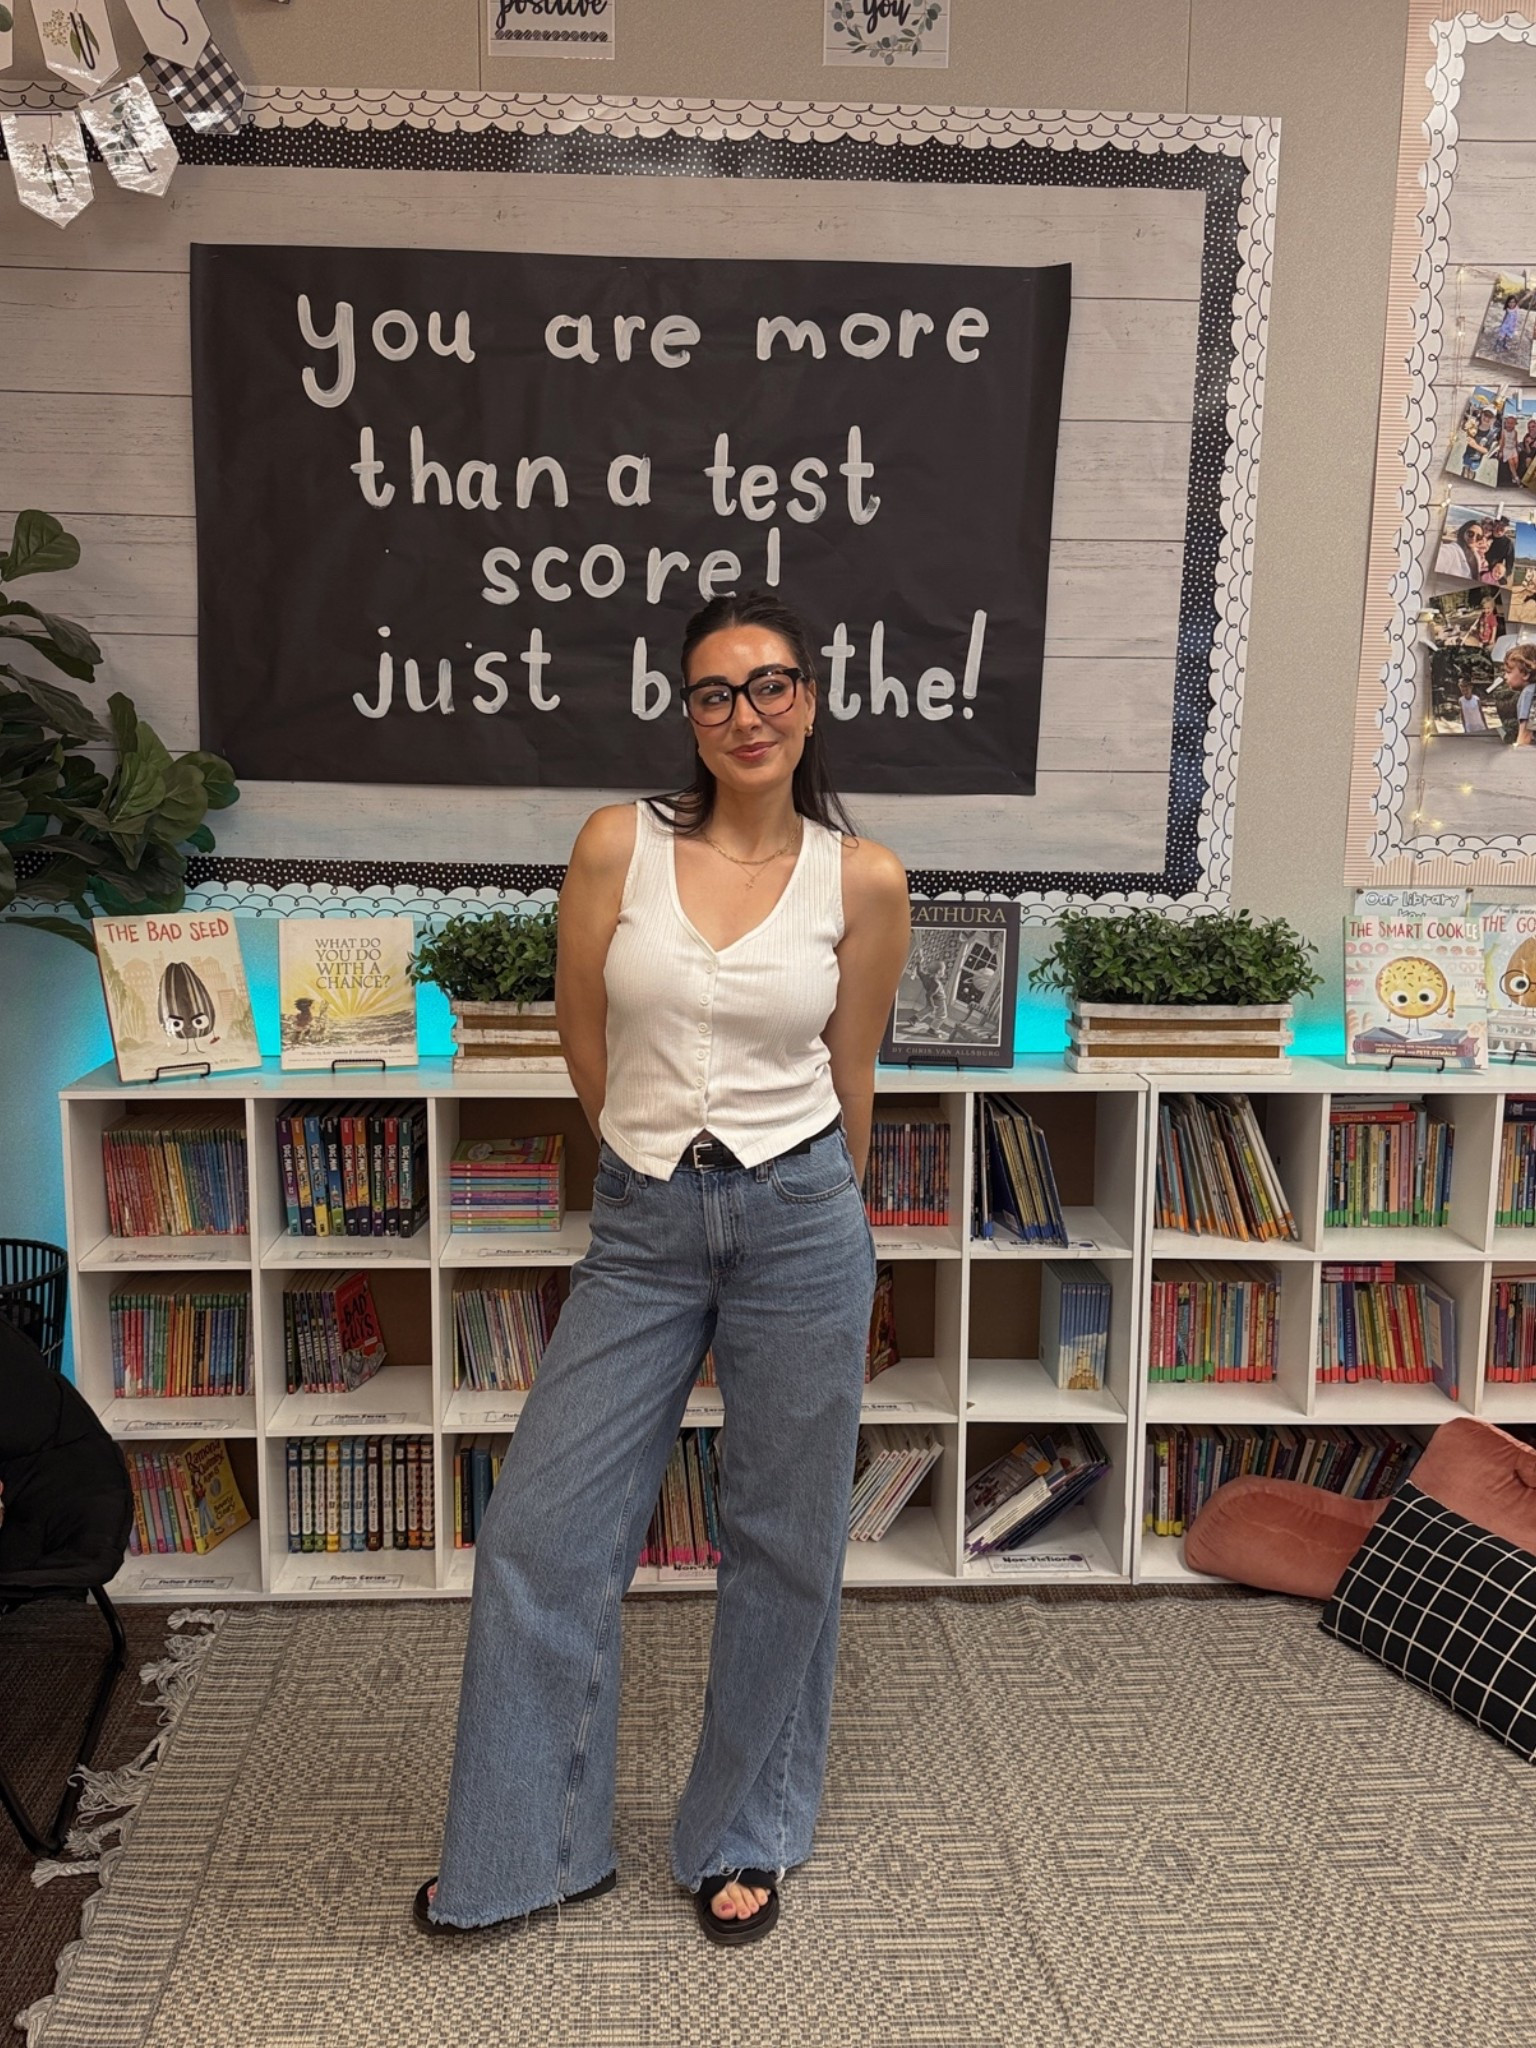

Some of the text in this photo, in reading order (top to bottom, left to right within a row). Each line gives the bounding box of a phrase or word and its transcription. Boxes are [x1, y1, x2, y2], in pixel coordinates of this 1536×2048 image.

[861, 0, 911, 33] you
[297, 294, 990, 408] you are more
[349, 425, 881, 525] than a test
[481, 527, 781, 605] score!
[352, 626, 561, 719] just
[1365, 891, 1399, 907] Our
[103, 917, 230, 944] THE BAD SEED
[1349, 920, 1479, 941] THE SMART COOKIE
[1482, 914, 1507, 933] THE
[315, 938, 382, 949] WHAT DO
[315, 949, 382, 962] YOU DO
[315, 962, 382, 976] WITH A
[315, 974, 391, 990] CHANCE?
